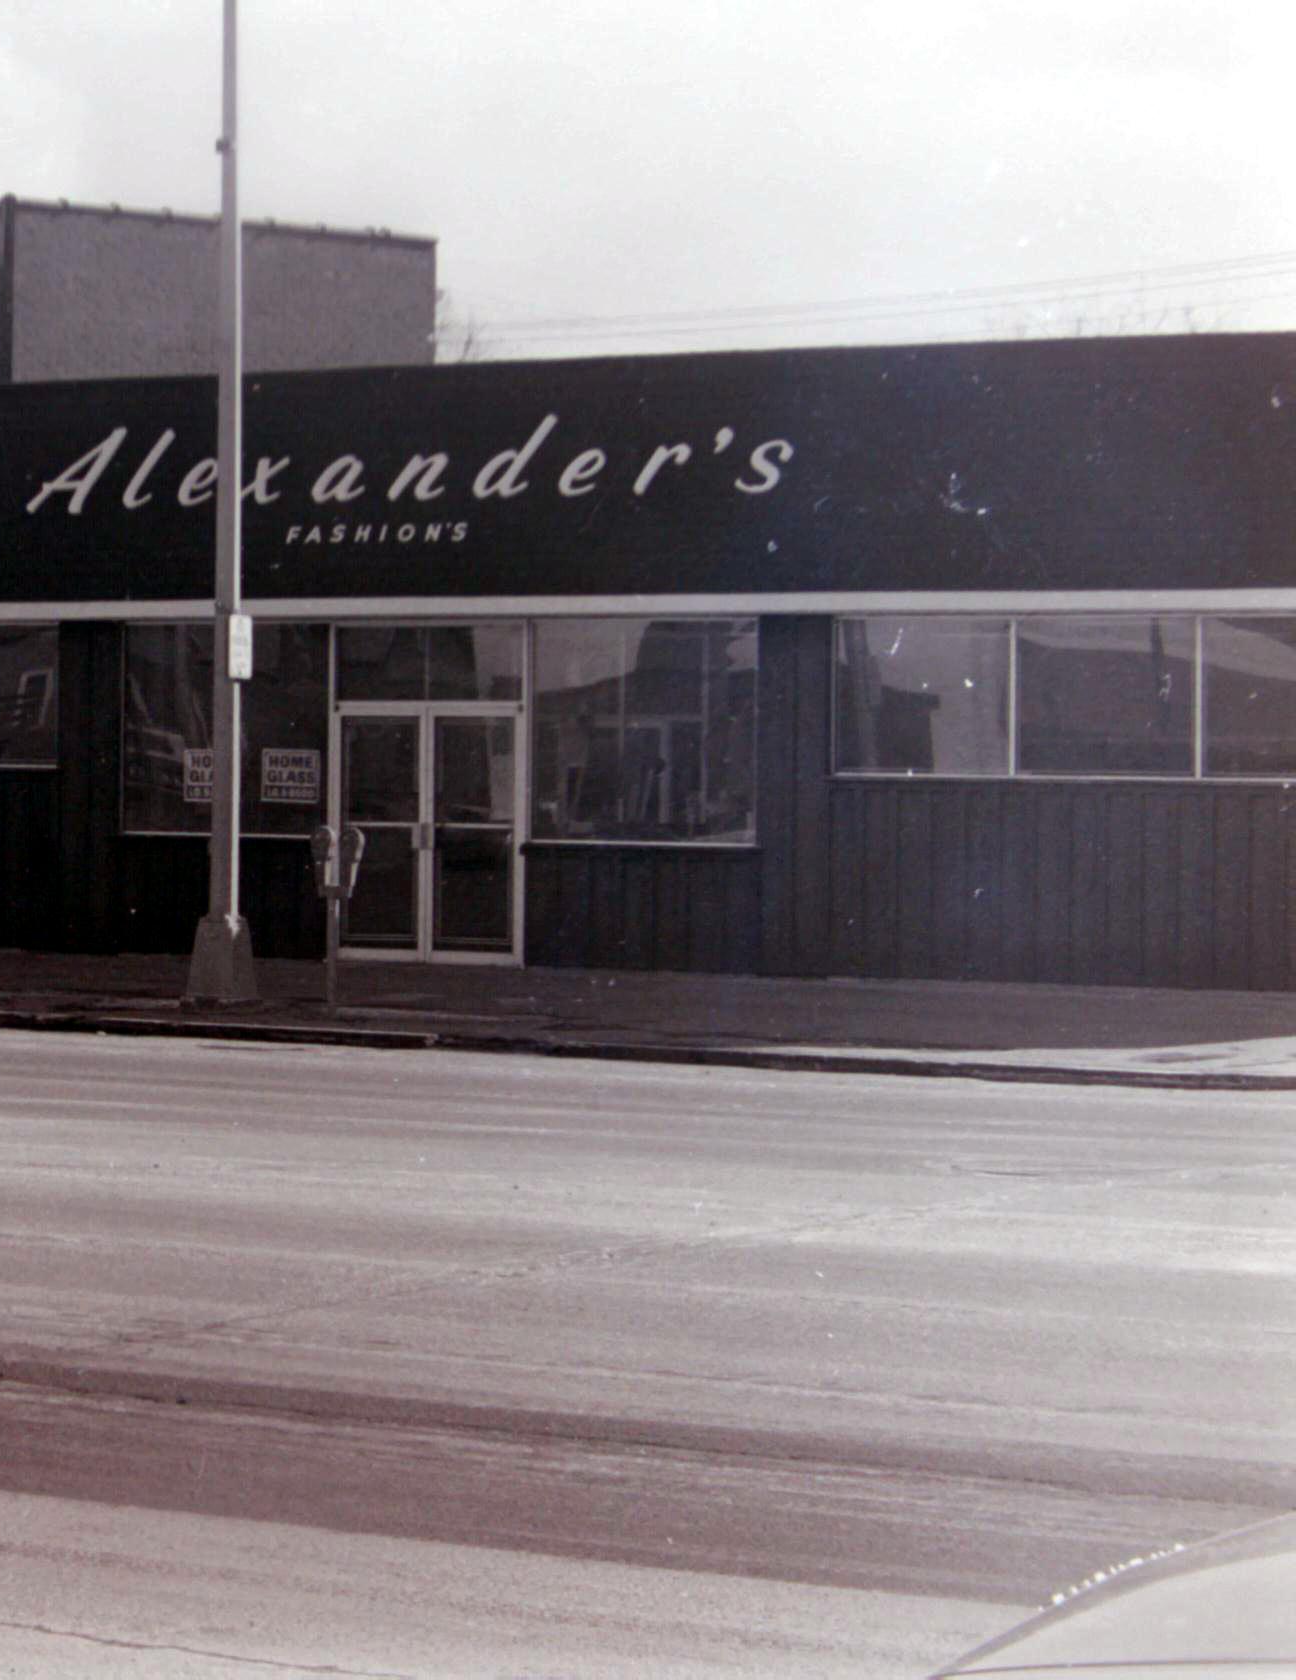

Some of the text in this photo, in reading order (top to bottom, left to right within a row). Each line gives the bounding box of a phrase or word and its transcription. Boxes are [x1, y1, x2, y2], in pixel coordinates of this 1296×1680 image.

[26, 413, 794, 515] Alexander's
[285, 522, 468, 545] FASHION'S
[191, 755, 212, 769] HO
[269, 755, 314, 769] HOME
[267, 770, 315, 784] GLASS
